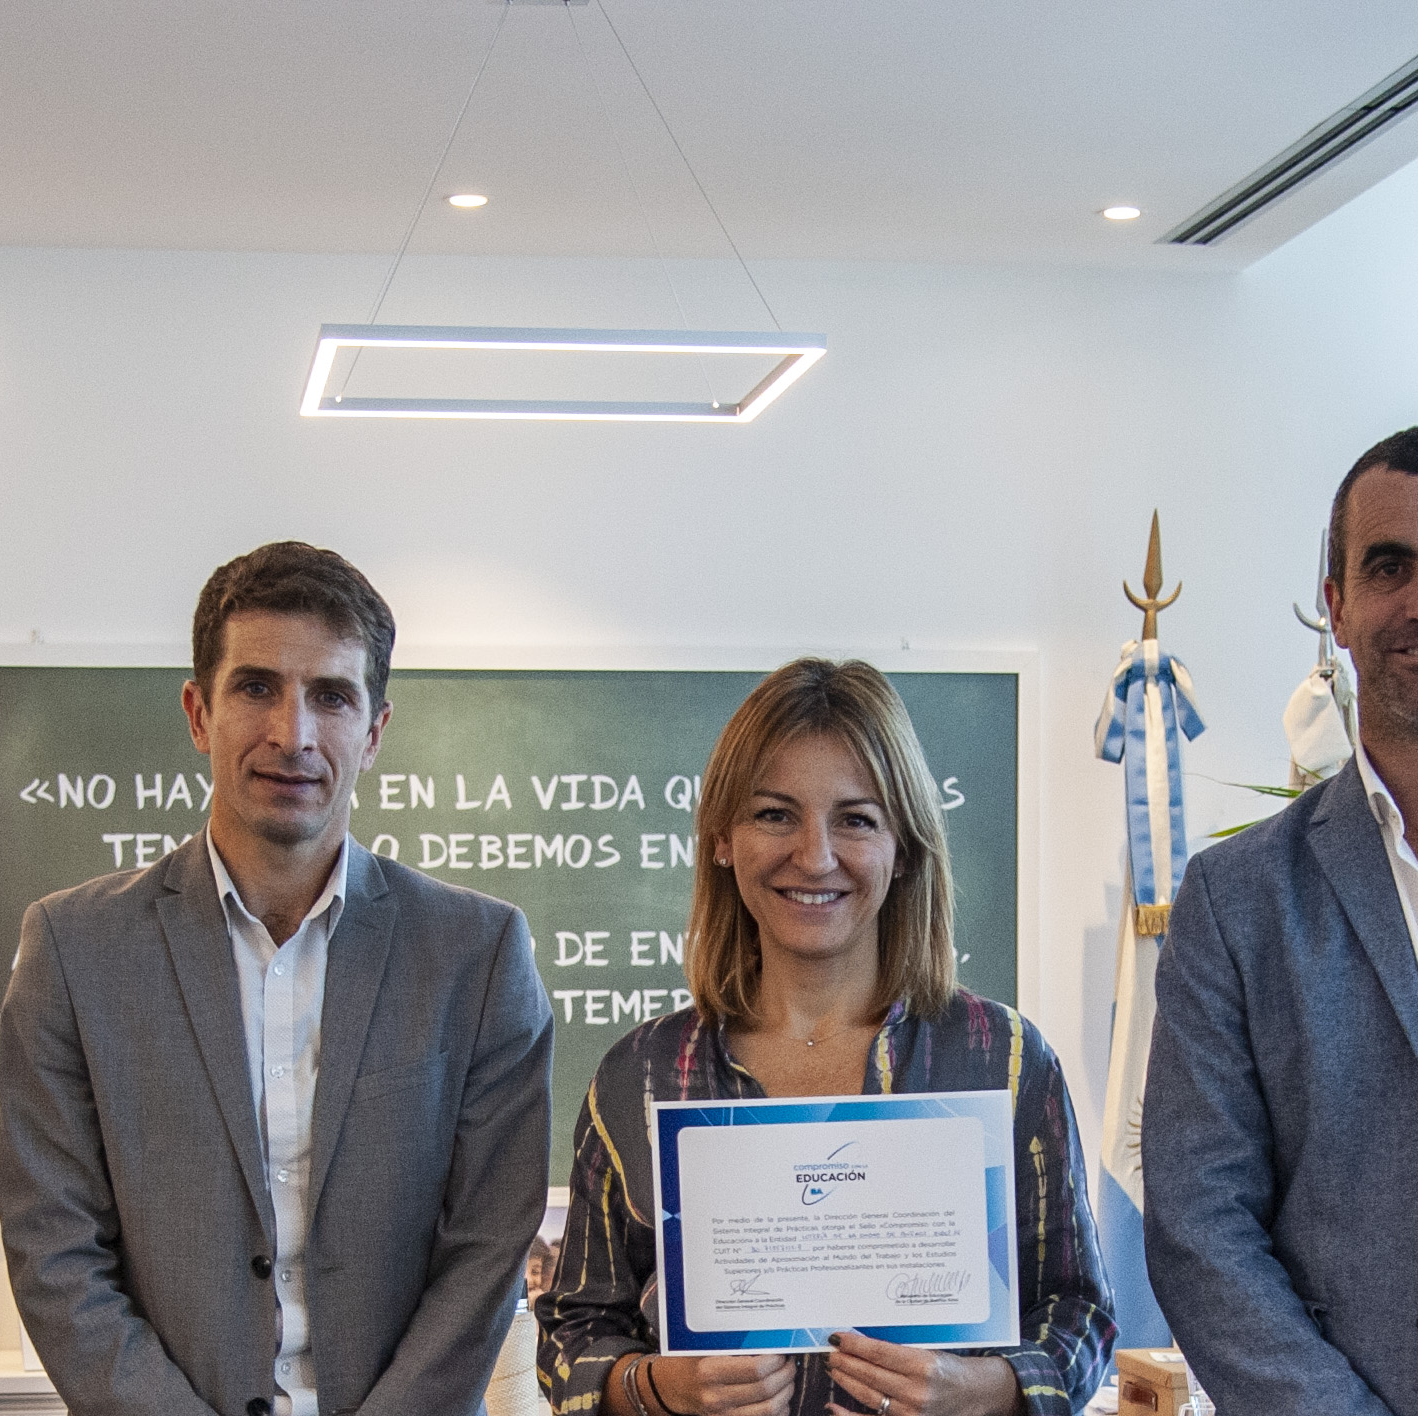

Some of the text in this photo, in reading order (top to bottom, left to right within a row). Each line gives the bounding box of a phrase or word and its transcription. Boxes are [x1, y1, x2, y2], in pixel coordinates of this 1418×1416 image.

[380, 774, 436, 810] EN
[455, 774, 513, 812] LA
[531, 774, 645, 812] VIDA
[417, 833, 621, 870] DEBEMOS
[553, 931, 610, 967] DE
[796, 1169, 866, 1183] EDUCACIÓN
